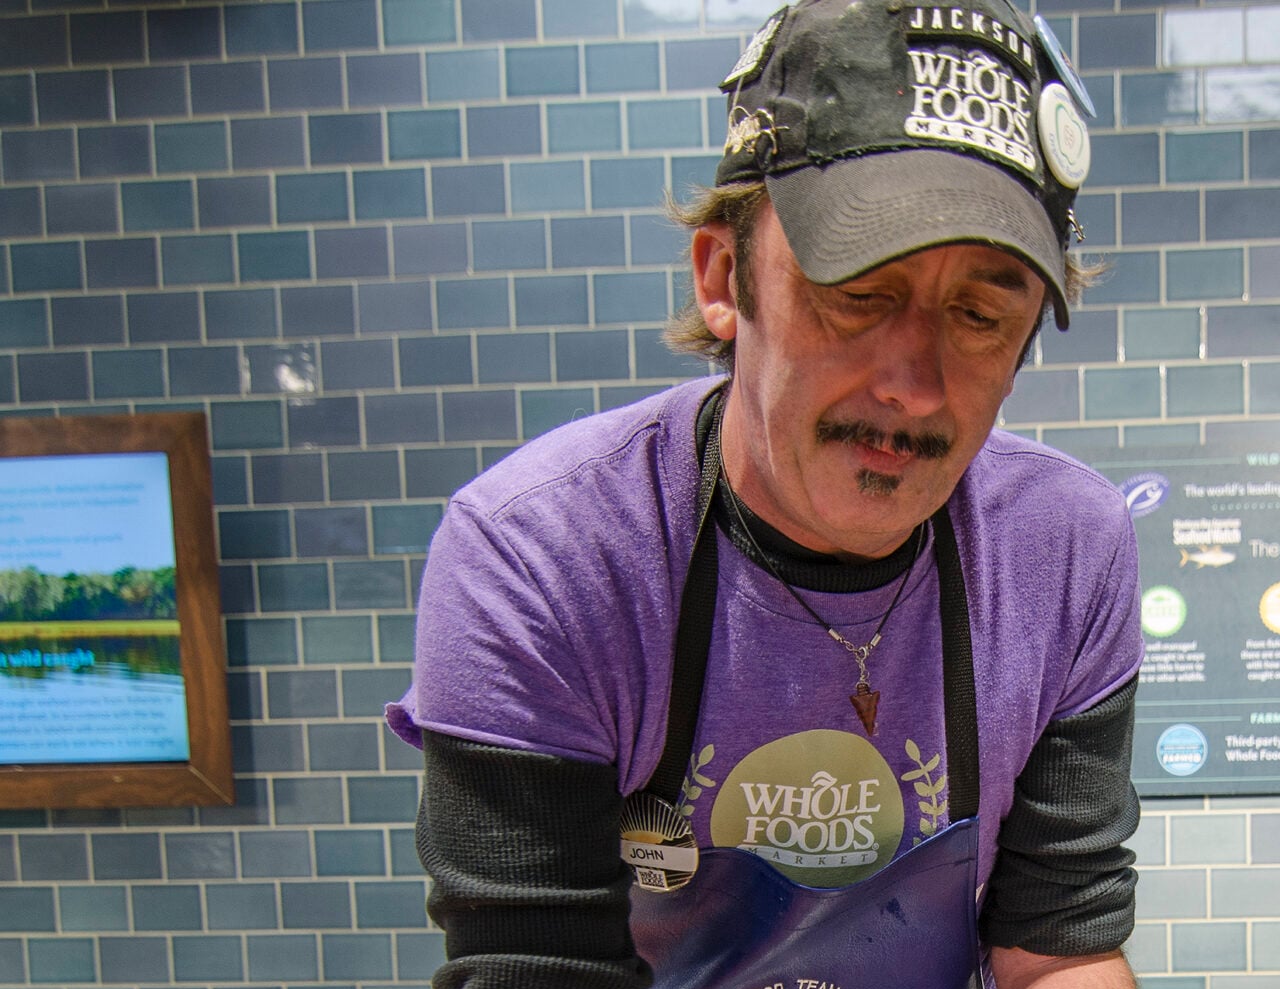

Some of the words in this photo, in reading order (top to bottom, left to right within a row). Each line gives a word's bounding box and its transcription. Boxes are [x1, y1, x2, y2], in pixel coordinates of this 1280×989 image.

[910, 8, 1033, 67] JACKSON
[907, 50, 1031, 118] WHOLE
[911, 84, 1033, 148] FOODS
[915, 121, 1031, 164] MARKET
[1246, 452, 1280, 466] WILD
[1184, 482, 1206, 498] The
[1207, 481, 1246, 497] world's
[1248, 538, 1280, 558] The
[8, 648, 42, 668] wild
[1225, 748, 1259, 762] Whole
[739, 771, 881, 820] WHOLE
[743, 814, 875, 853] FOODS
[630, 848, 665, 861] JOHN
[748, 847, 870, 866] MARKET
